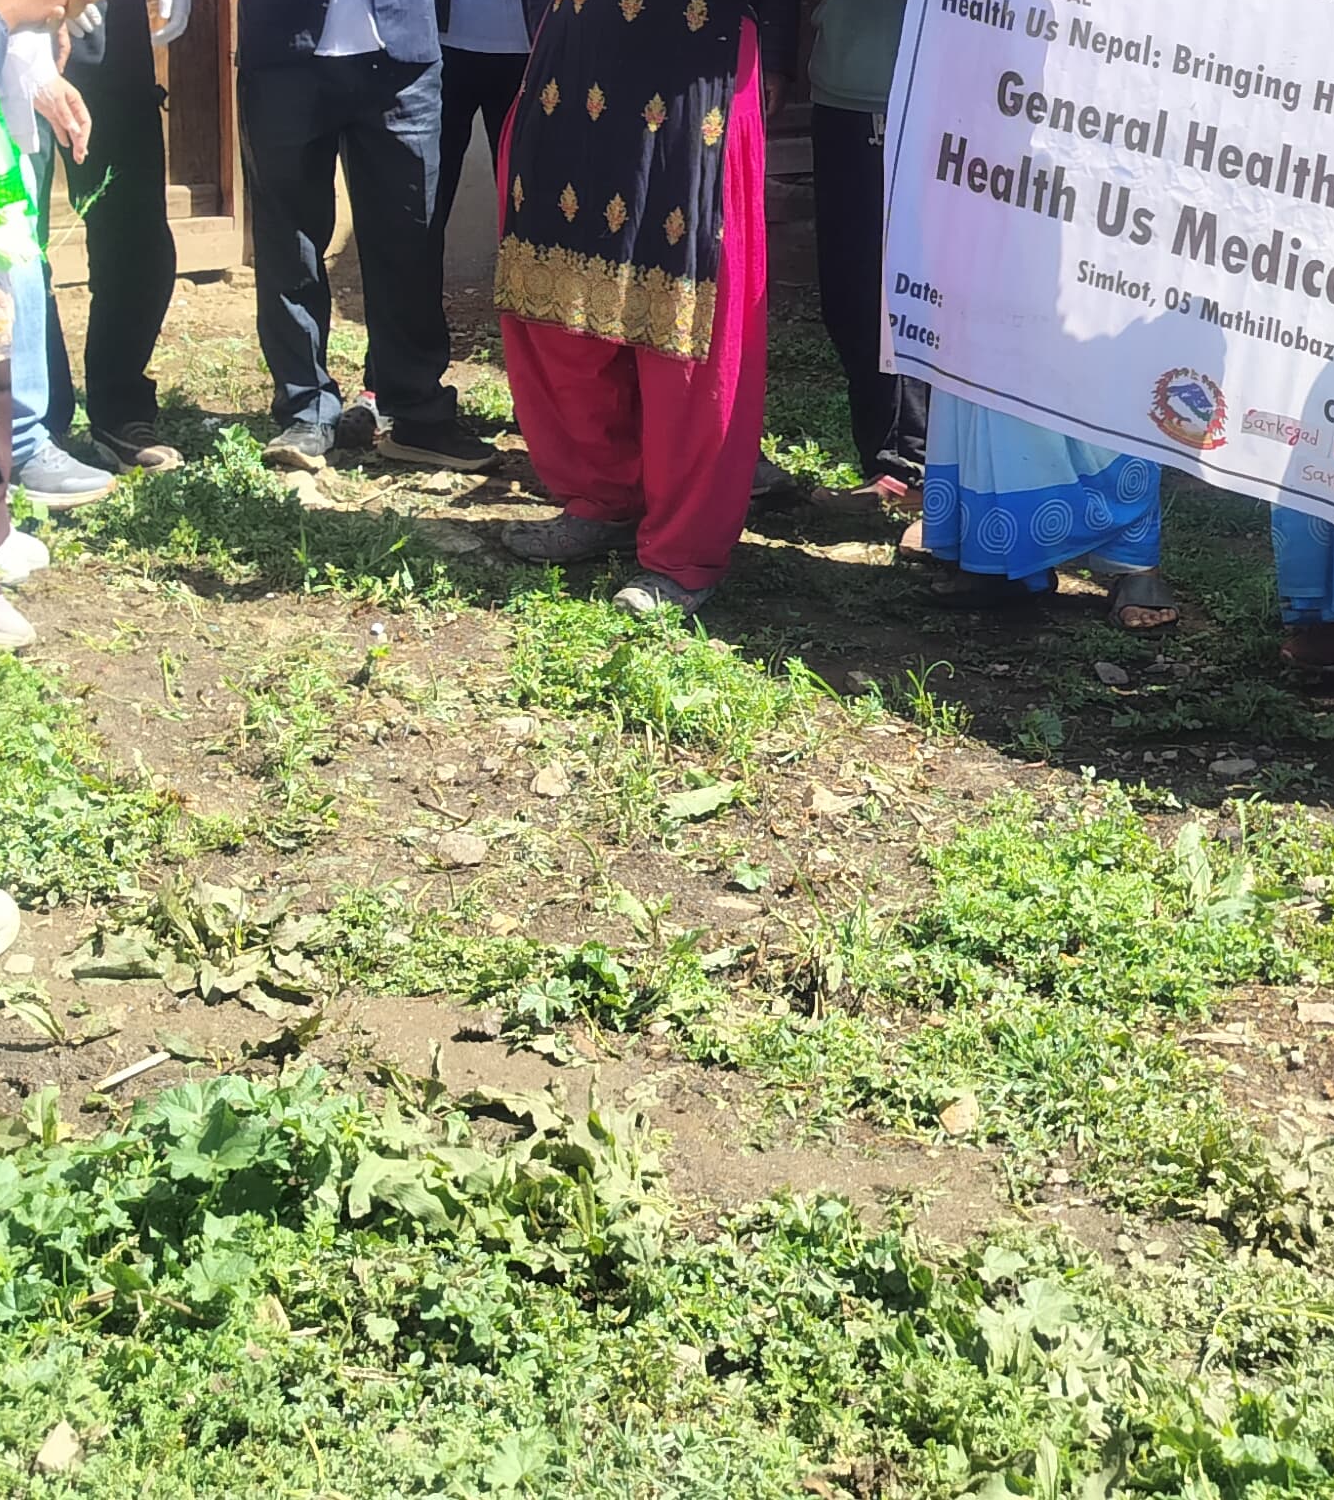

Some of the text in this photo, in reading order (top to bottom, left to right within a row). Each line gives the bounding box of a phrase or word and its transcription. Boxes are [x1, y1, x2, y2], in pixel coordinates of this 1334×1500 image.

[1025, 6, 1058, 42] Us
[1068, 18, 1162, 68] Nepal:
[1171, 45, 1303, 111] Bringing
[996, 70, 1167, 161] General
[935, 131, 1078, 223] Health
[1094, 179, 1154, 247] Us
[895, 272, 943, 308] Date:
[1076, 258, 1158, 309] Simkot,
[1164, 284, 1192, 315] 05
